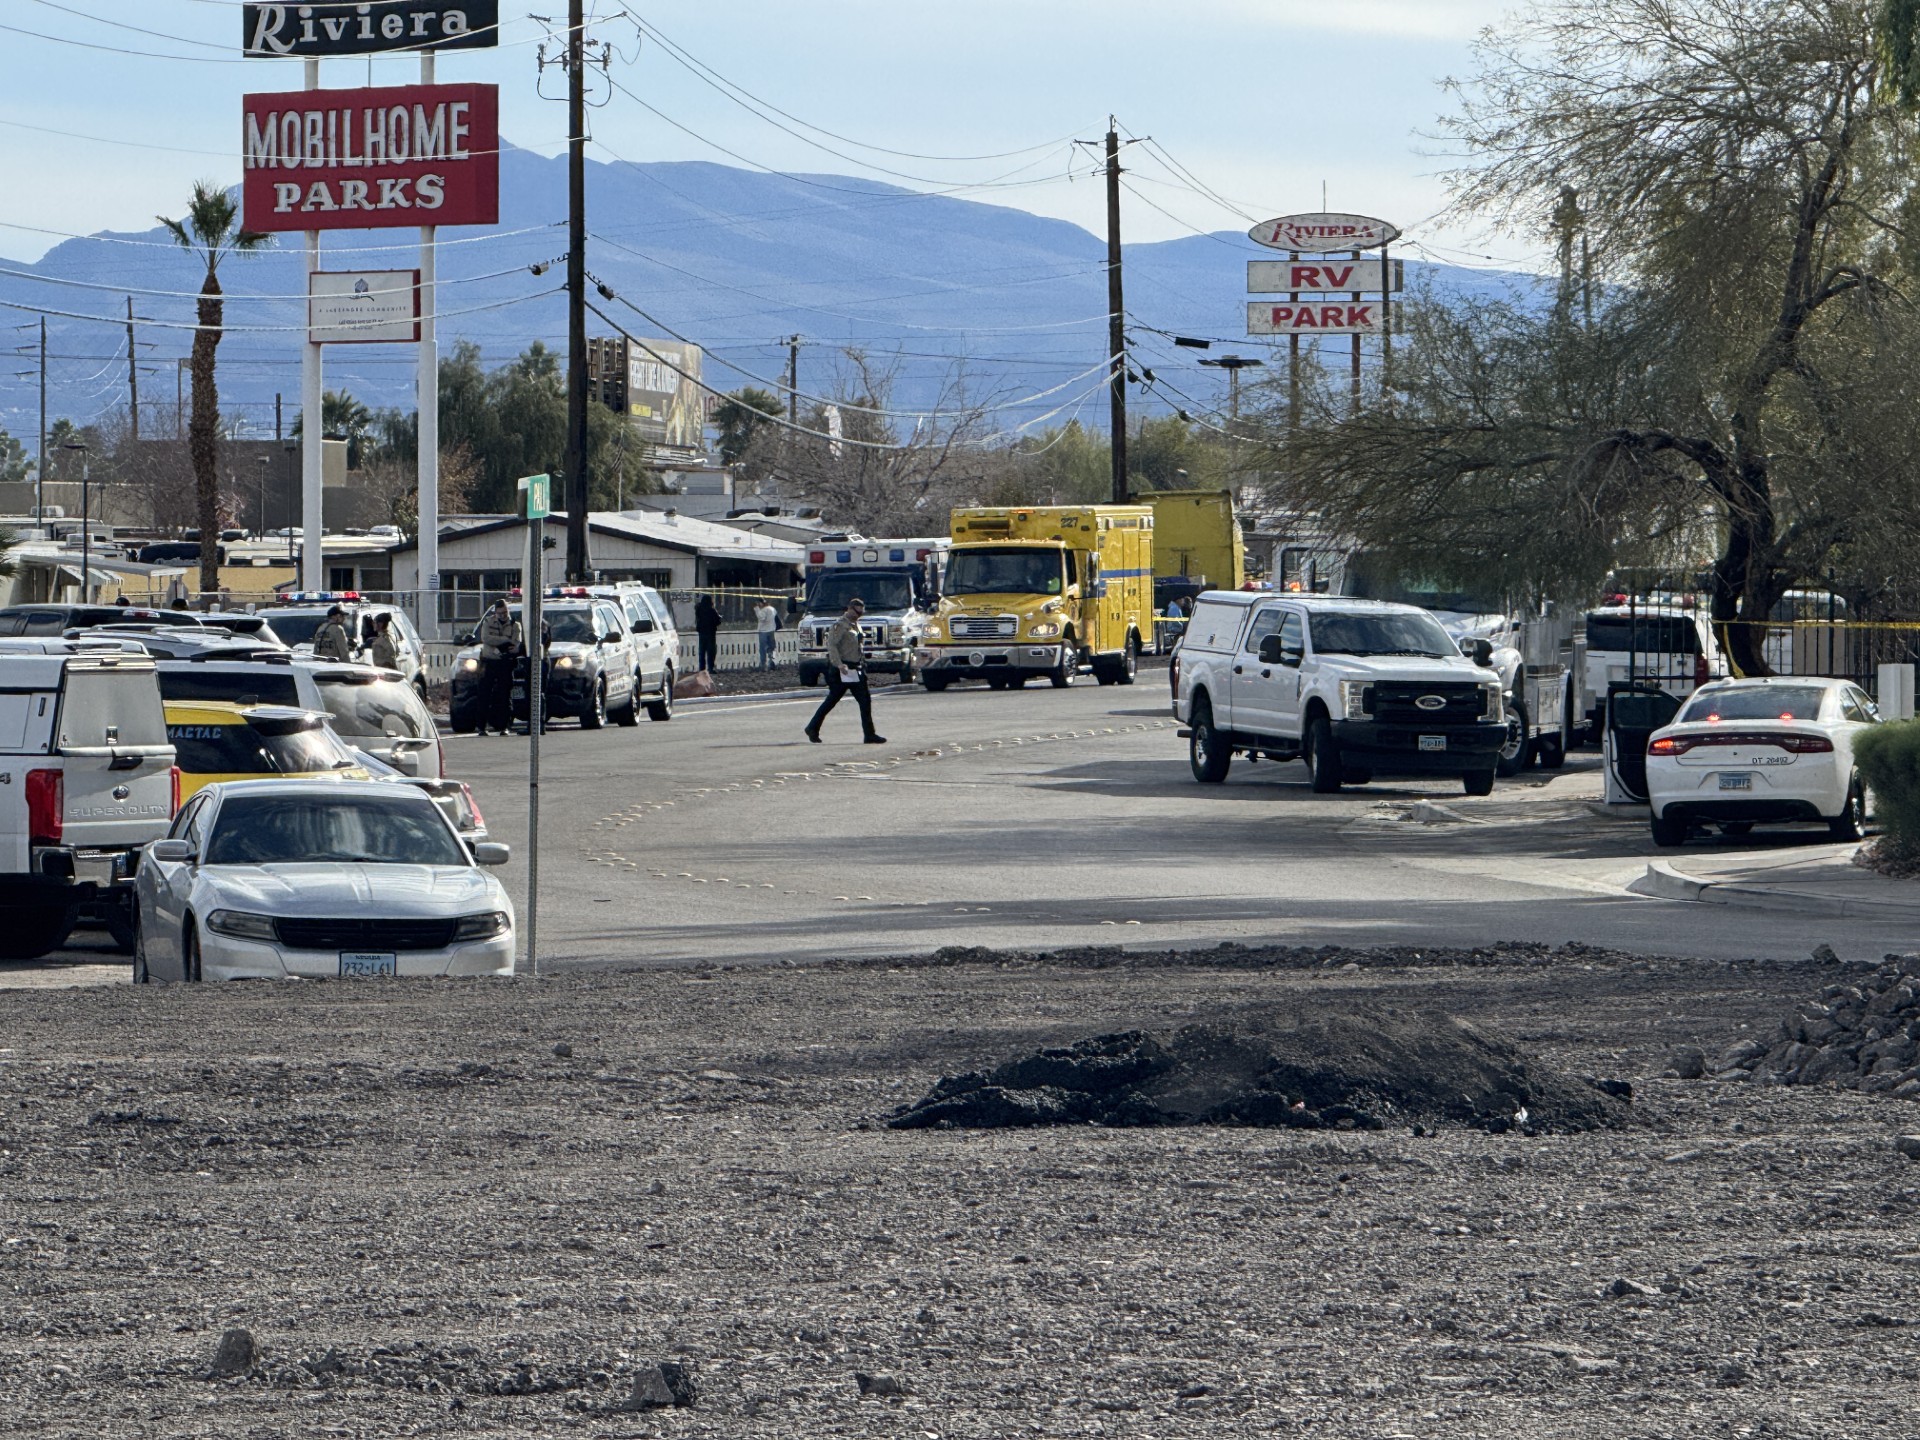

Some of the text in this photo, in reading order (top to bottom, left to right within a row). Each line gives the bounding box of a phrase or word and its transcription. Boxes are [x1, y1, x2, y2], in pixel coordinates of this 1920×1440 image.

[250, 4, 472, 54] Riviera
[273, 173, 446, 213] PARKS
[1269, 222, 1375, 248] RIVIERA
[1290, 266, 1355, 288] RV
[1271, 305, 1374, 328] PARK
[1060, 516, 1079, 528] 227
[69, 804, 167, 817] SUPER DUTY
